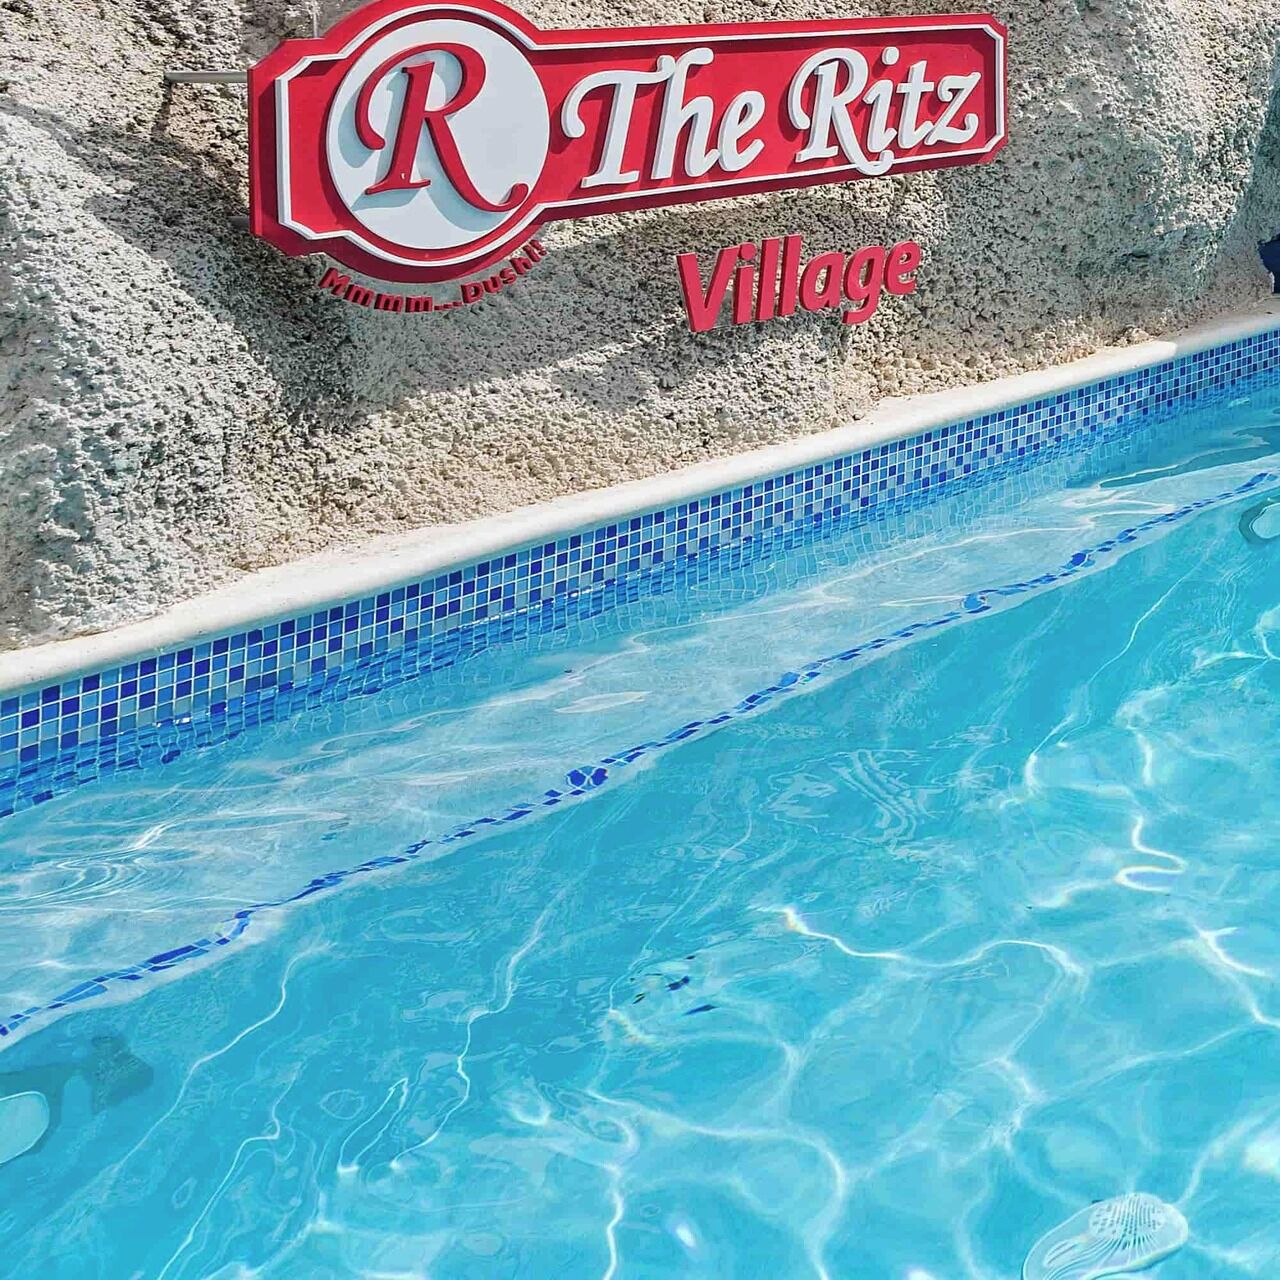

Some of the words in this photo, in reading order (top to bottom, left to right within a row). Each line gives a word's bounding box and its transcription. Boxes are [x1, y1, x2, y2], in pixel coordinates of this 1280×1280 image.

[358, 42, 529, 211] R
[562, 47, 765, 187] The
[790, 46, 981, 175] Ritz
[676, 234, 921, 333] Village
